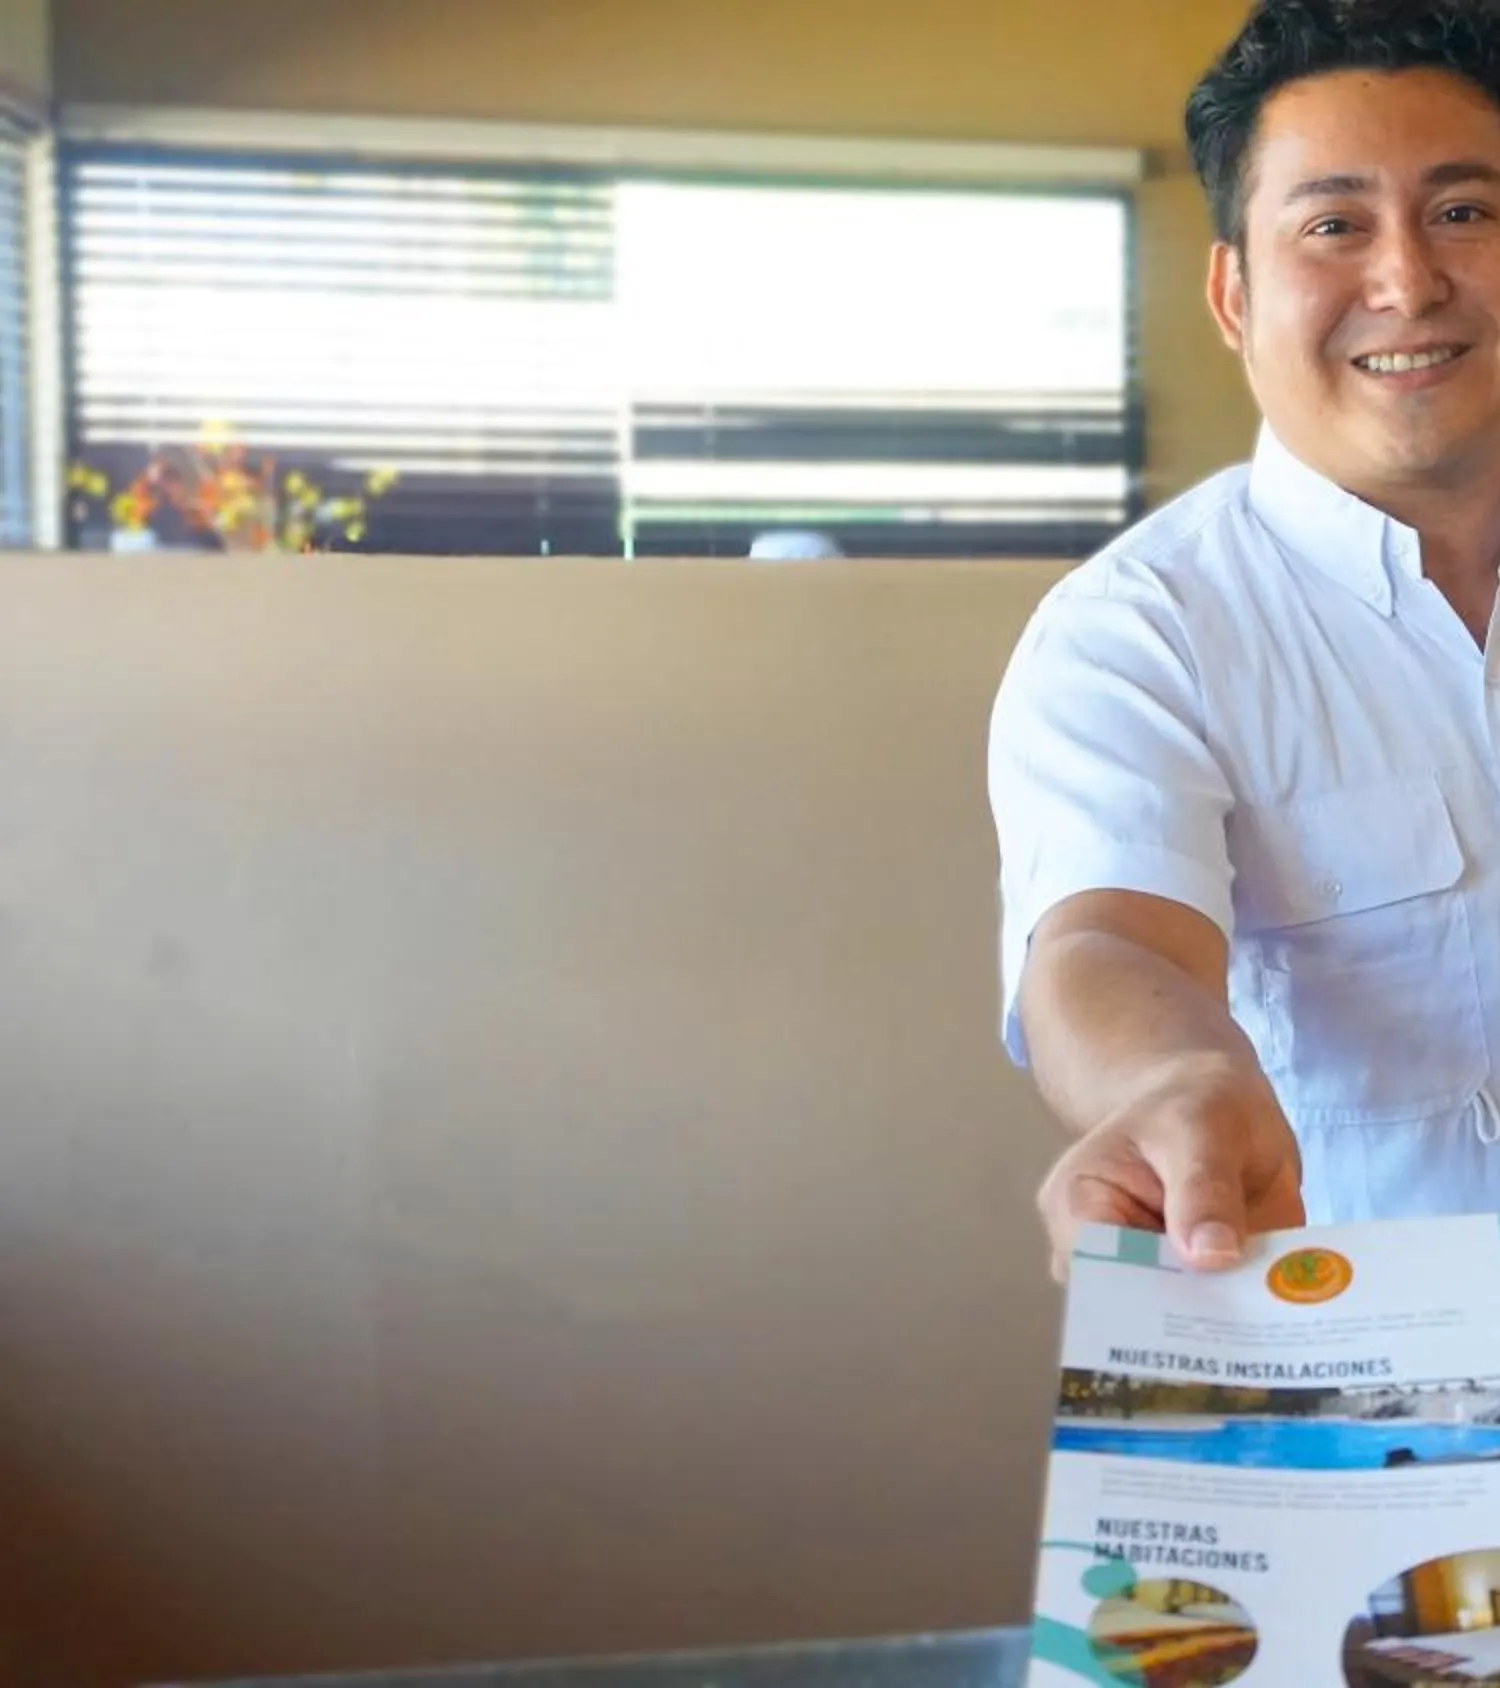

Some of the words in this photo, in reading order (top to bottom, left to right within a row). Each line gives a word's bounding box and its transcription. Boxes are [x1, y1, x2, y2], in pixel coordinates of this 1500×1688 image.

[1108, 1347, 1219, 1376] NUESTRAS
[1226, 1358, 1393, 1379] INSTALACIONES
[1096, 1518, 1218, 1545] NUESTRAS
[1093, 1542, 1268, 1572] HABITACIONES
